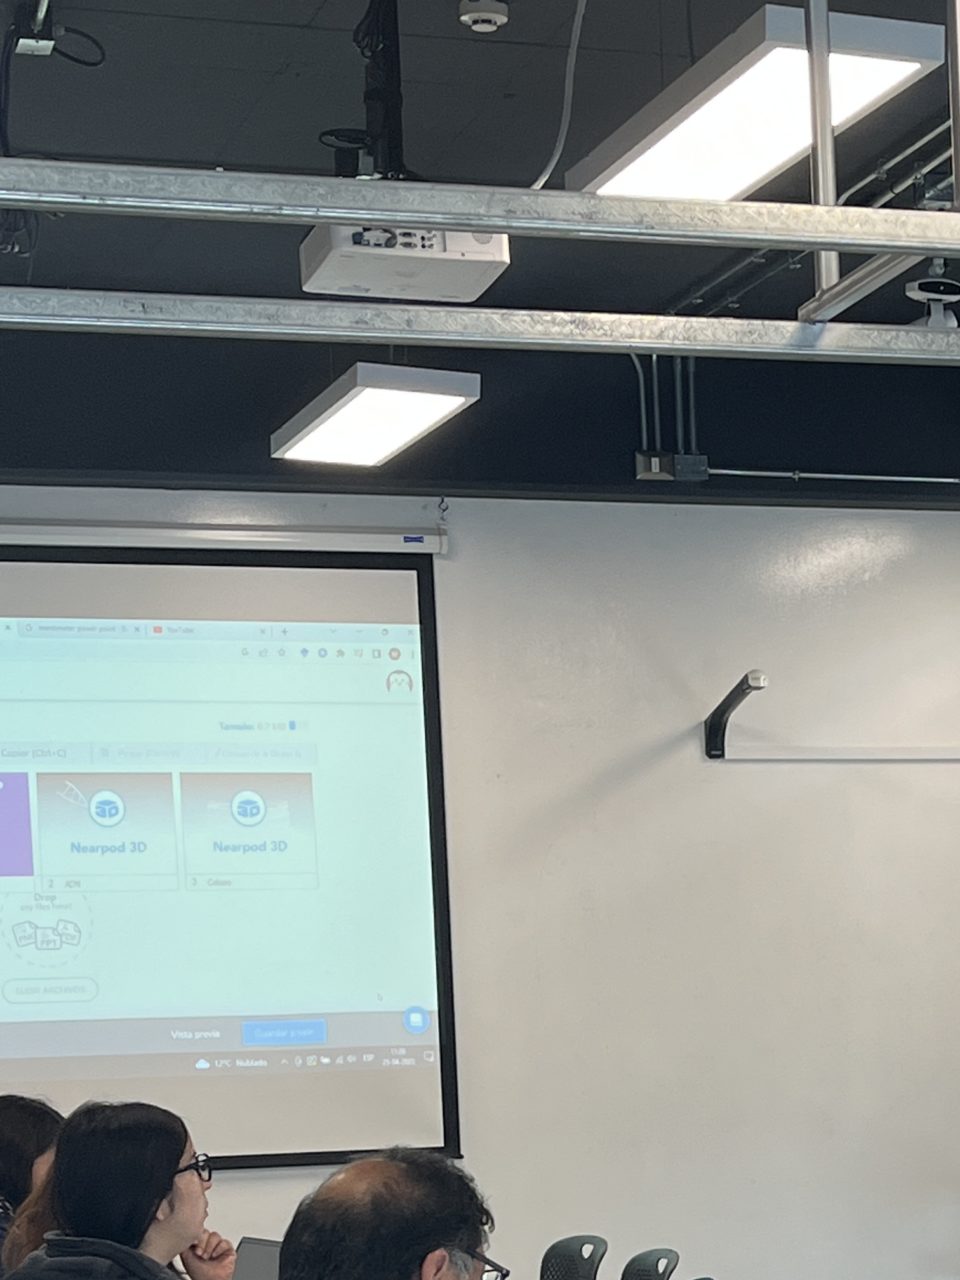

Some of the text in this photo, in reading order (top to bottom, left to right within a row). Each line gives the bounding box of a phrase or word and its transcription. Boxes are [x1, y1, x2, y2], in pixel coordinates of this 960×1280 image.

[70, 841, 147, 855] Nearpod 3D
[213, 840, 288, 855] Nearpod 3D
[34, 892, 57, 904] Drop
[171, 1029, 221, 1041] Vista previa
